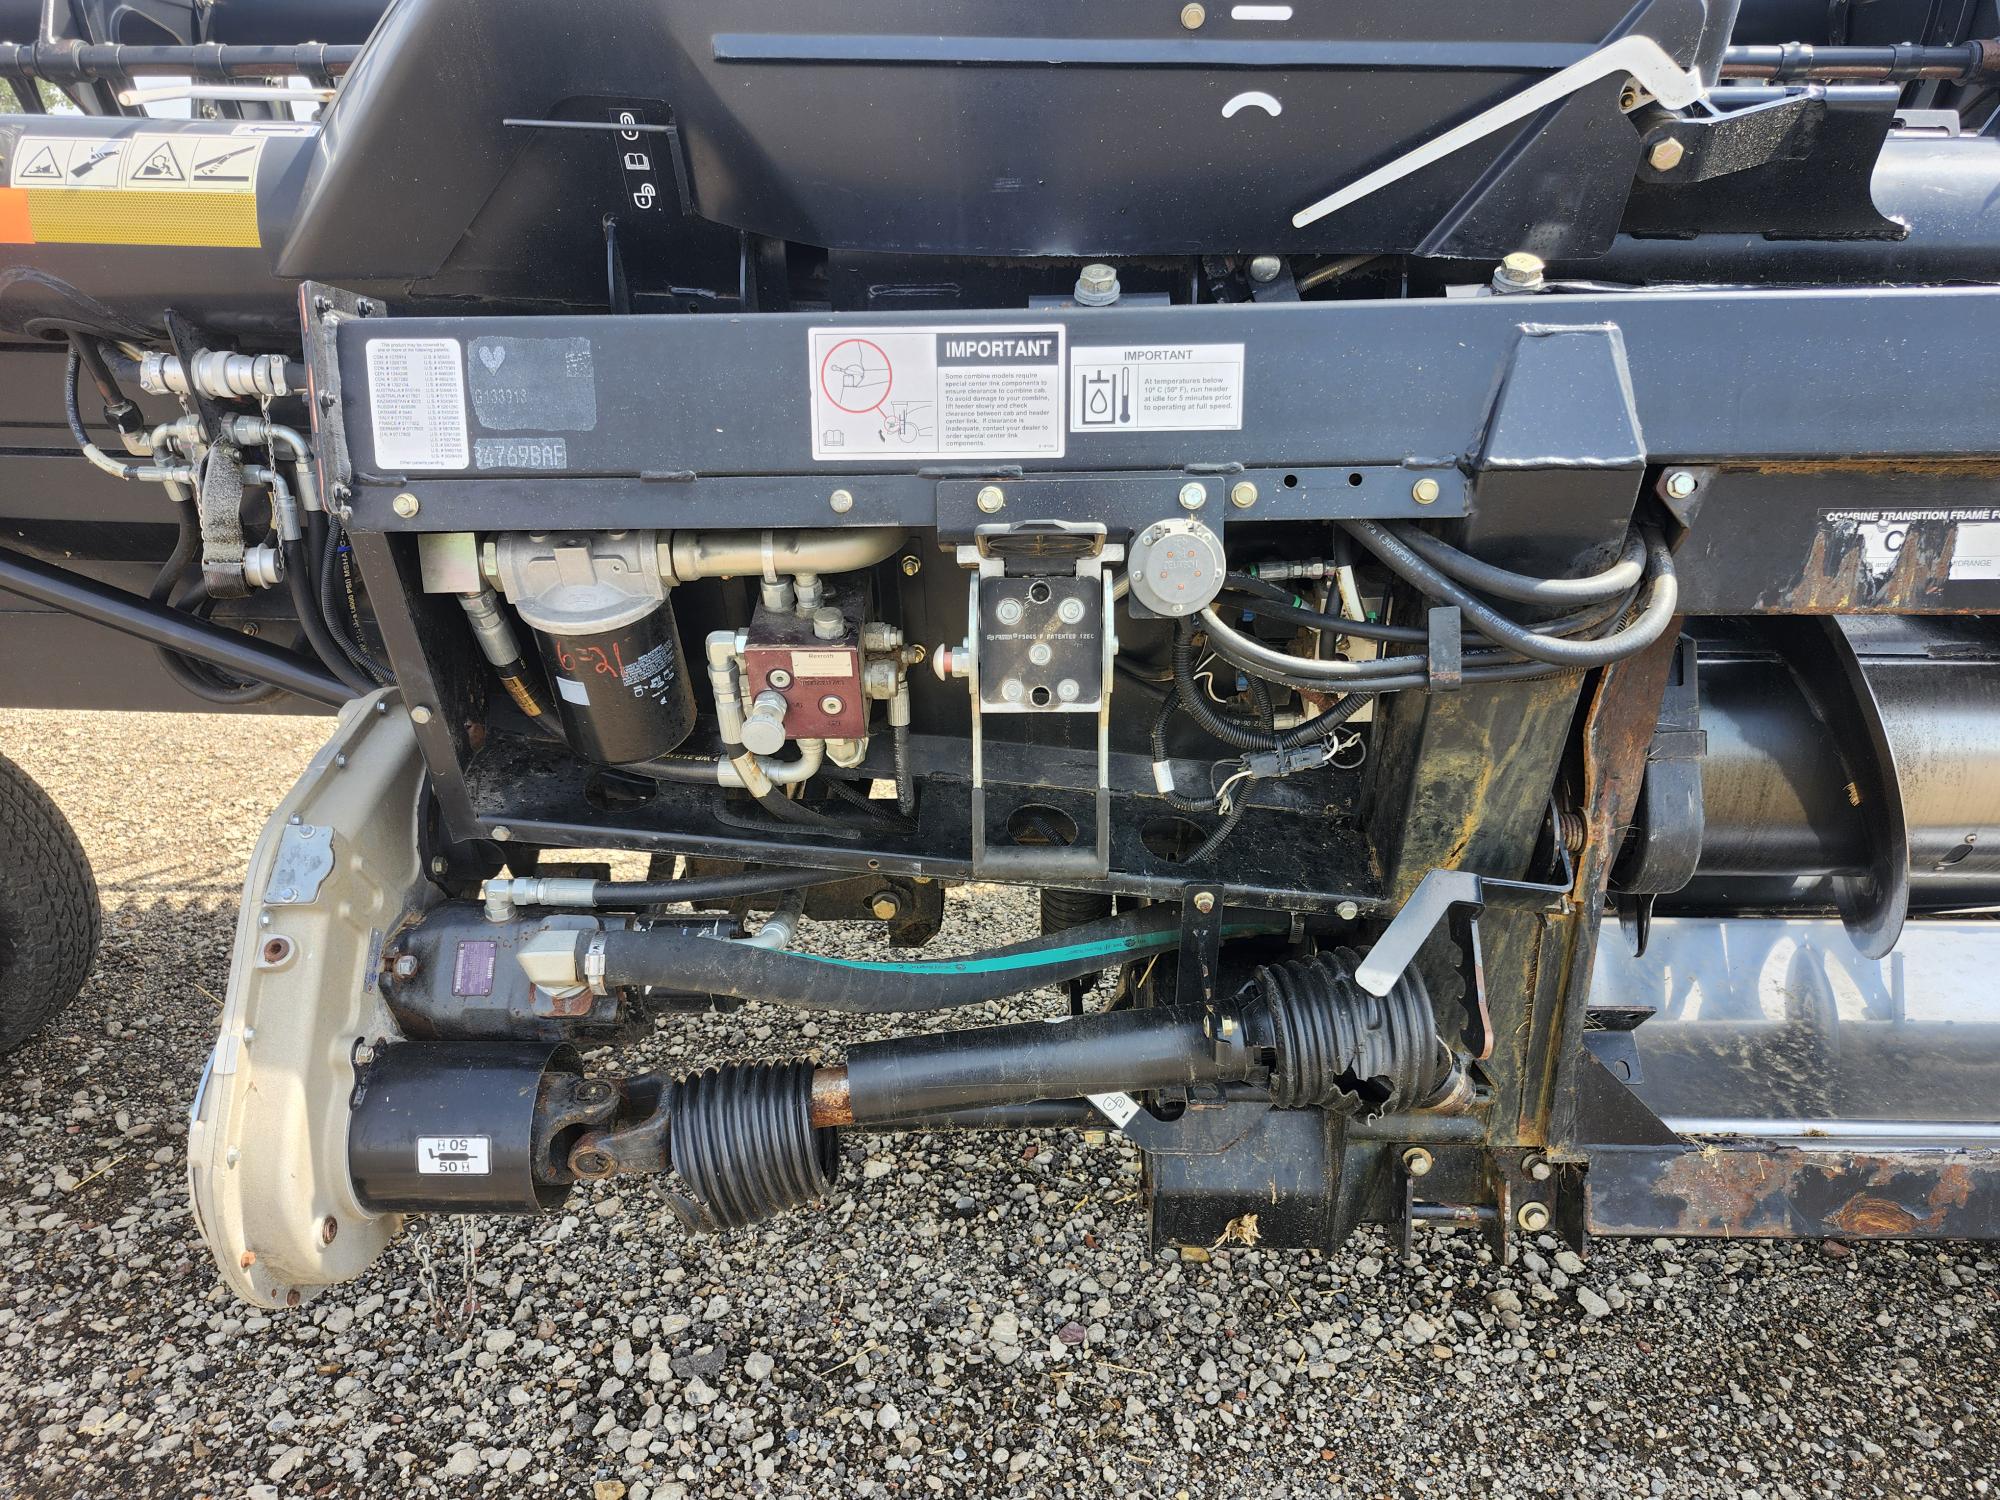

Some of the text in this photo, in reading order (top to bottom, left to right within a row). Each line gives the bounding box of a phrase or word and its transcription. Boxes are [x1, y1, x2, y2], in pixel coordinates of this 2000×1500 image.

[946, 340, 1052, 358] IMPORTANT
[1124, 350, 1193, 361] IMPORTANT
[1826, 511, 1879, 521] COMBINE
[1882, 511, 1948, 520] TRANSITION
[1950, 510, 1990, 520] FRAME
[341, 552, 350, 577] MSHA
[450, 1140, 468, 1150] 50
[439, 1162, 457, 1172] 50
